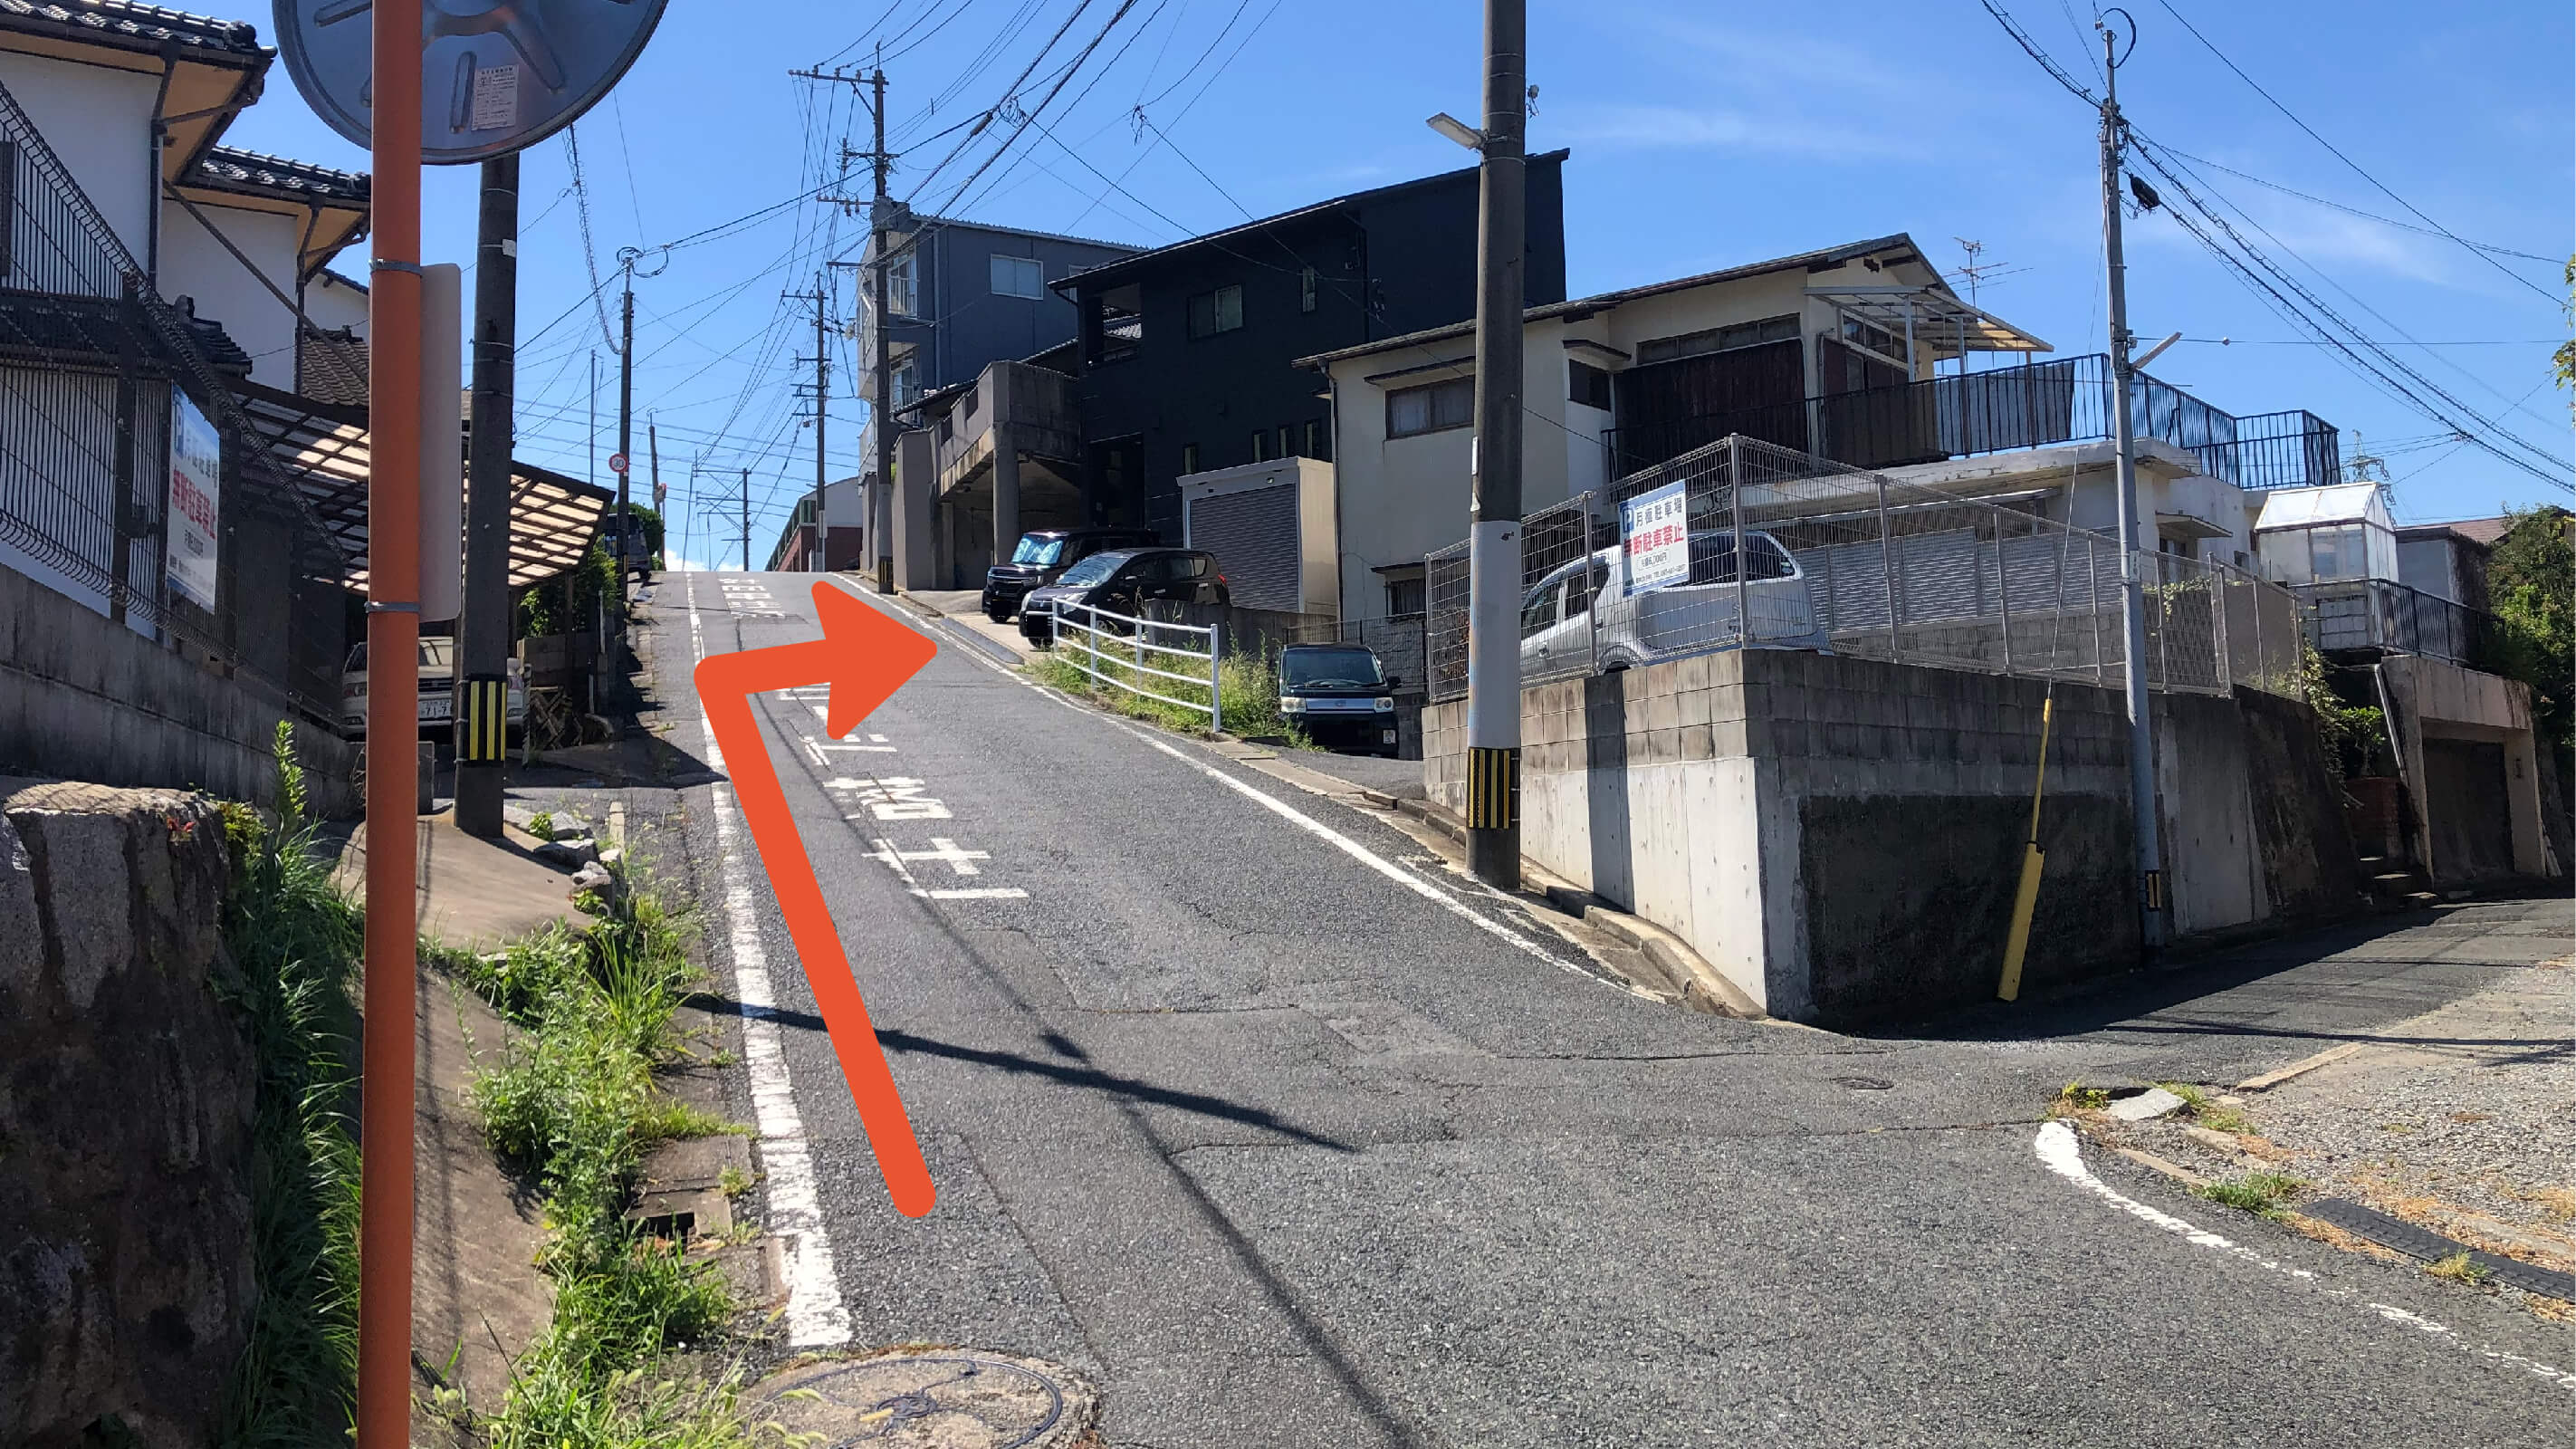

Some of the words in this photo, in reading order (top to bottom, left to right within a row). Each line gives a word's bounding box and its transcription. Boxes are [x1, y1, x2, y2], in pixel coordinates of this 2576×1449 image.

[1635, 497, 1682, 527] 月極駐車場
[1623, 522, 1684, 558] 無断駐車禁止
